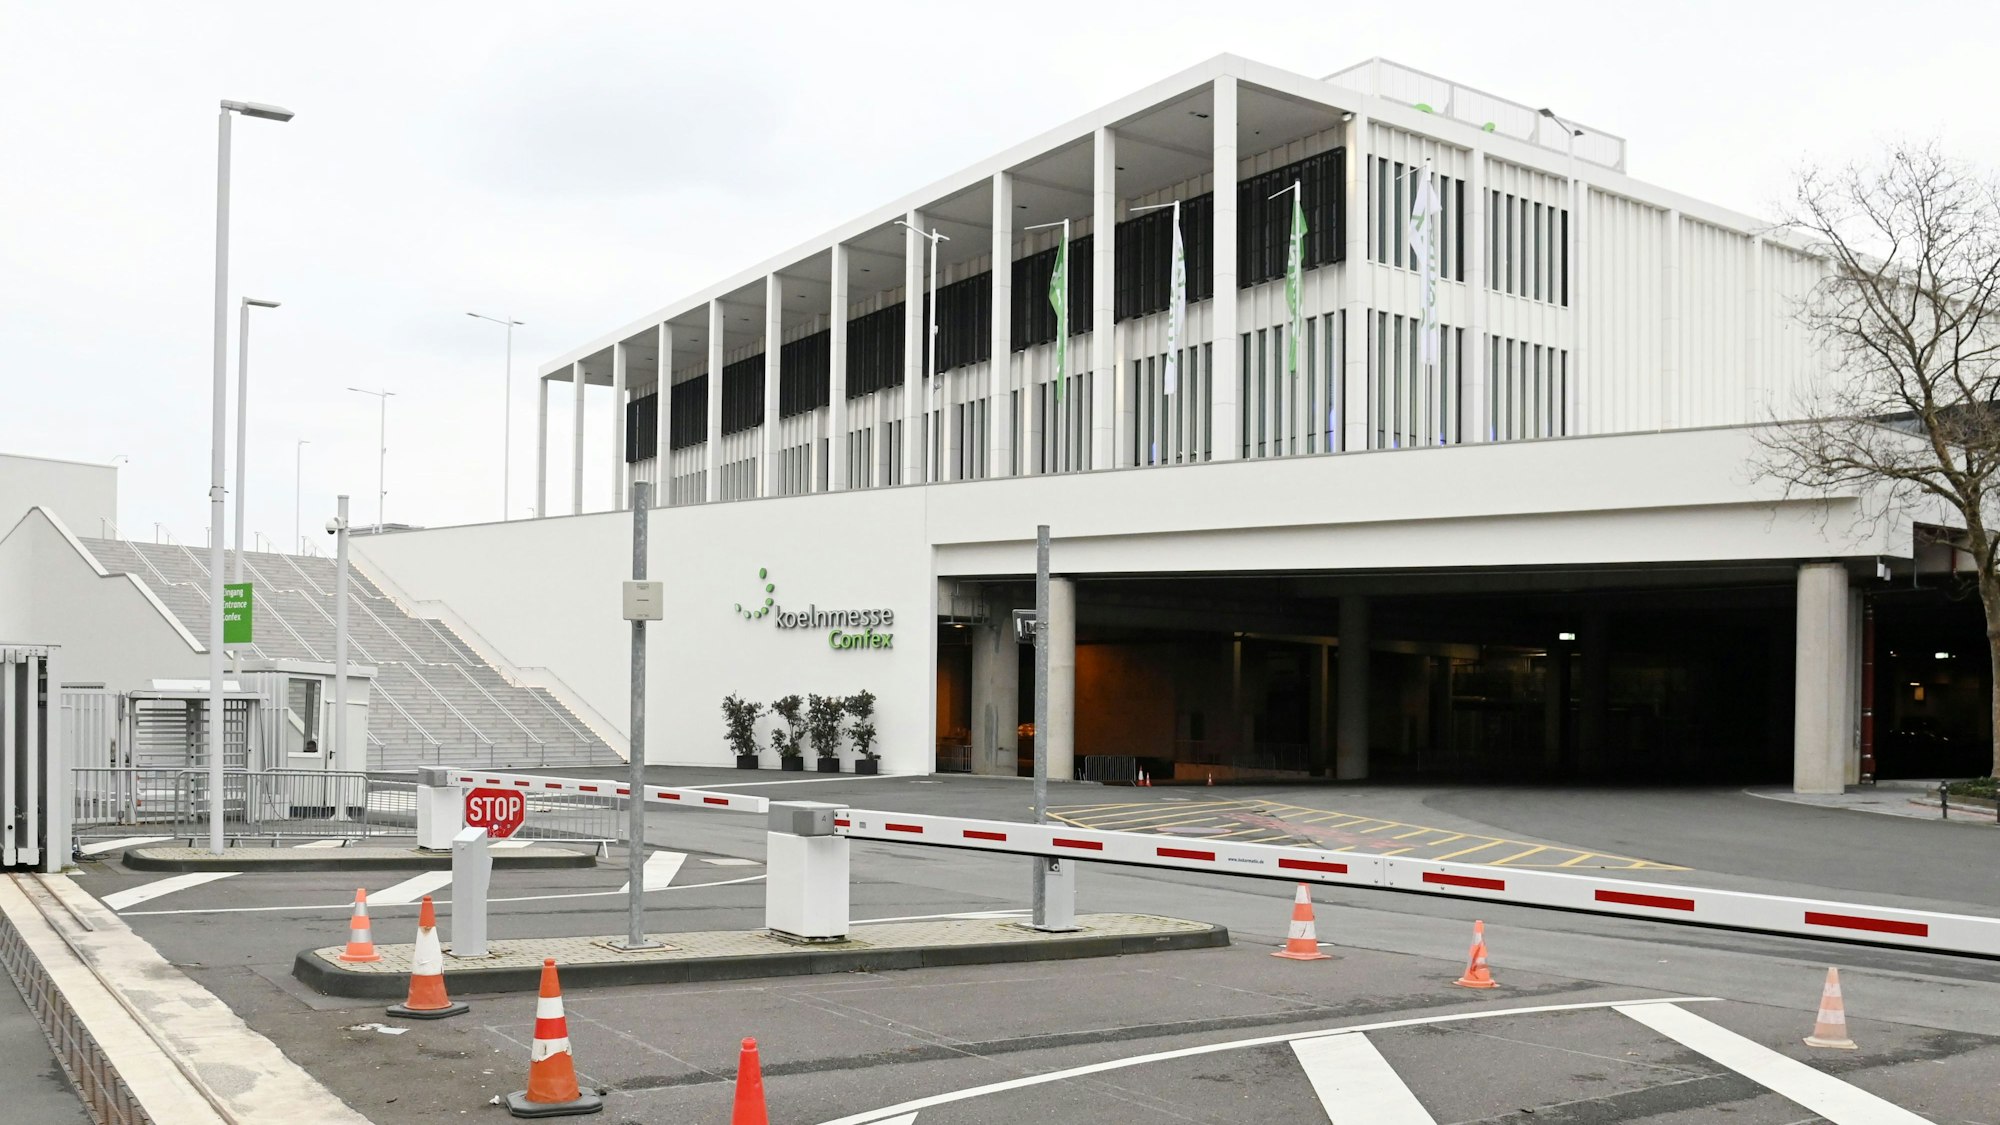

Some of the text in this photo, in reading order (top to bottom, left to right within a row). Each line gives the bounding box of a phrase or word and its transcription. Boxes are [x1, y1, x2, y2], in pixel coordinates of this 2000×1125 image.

[223, 600, 247, 609] ntrance
[223, 612, 242, 621] onfex
[775, 604, 894, 628] koelnmesse
[829, 628, 893, 650] Confex
[470, 797, 520, 821] STOP
